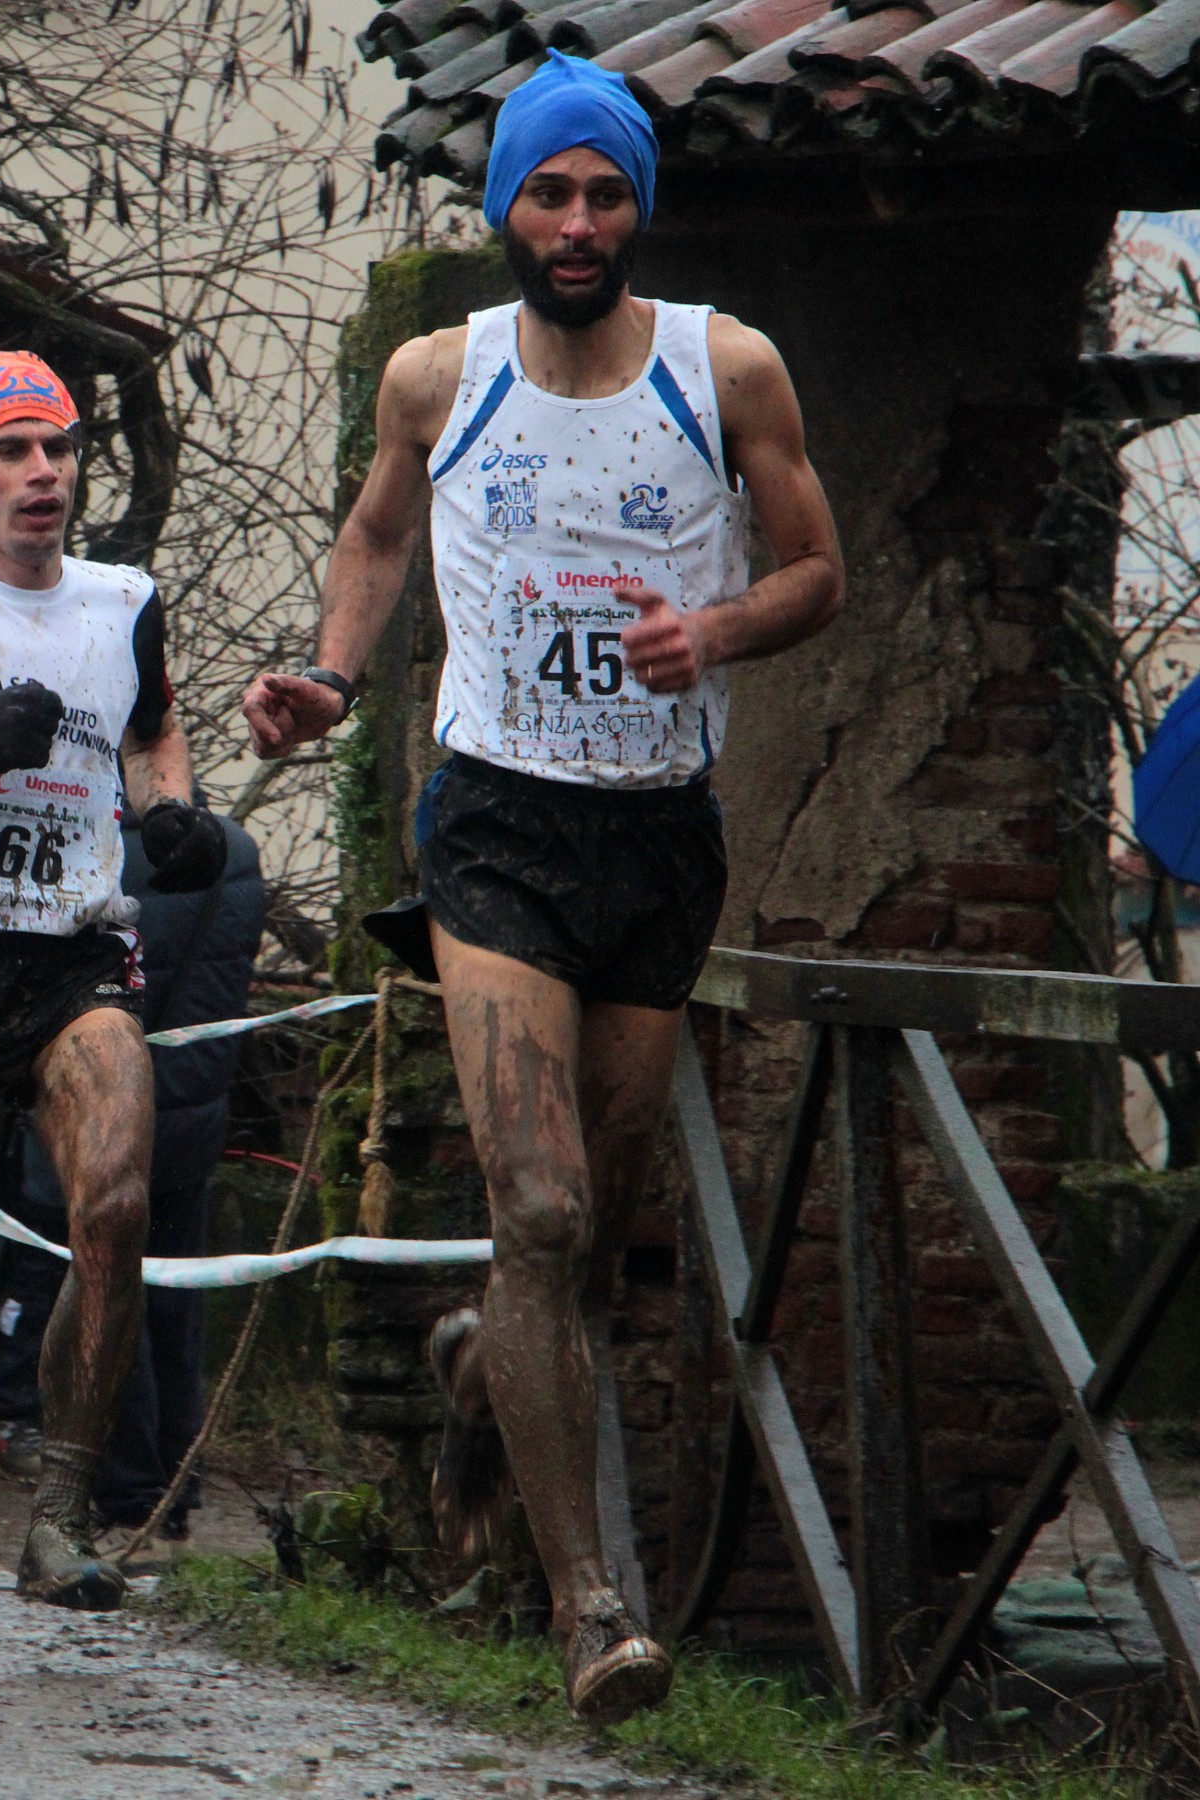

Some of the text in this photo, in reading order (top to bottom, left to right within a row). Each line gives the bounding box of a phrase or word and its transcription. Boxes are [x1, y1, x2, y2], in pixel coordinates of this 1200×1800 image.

[502, 454, 548, 469] asics
[504, 483, 535, 505] NEW
[487, 506, 536, 527] FOODS
[556, 571, 644, 589] Unendo
[539, 632, 623, 696] 45
[595, 711, 646, 735] SOFT
[25, 775, 90, 798] Unendo
